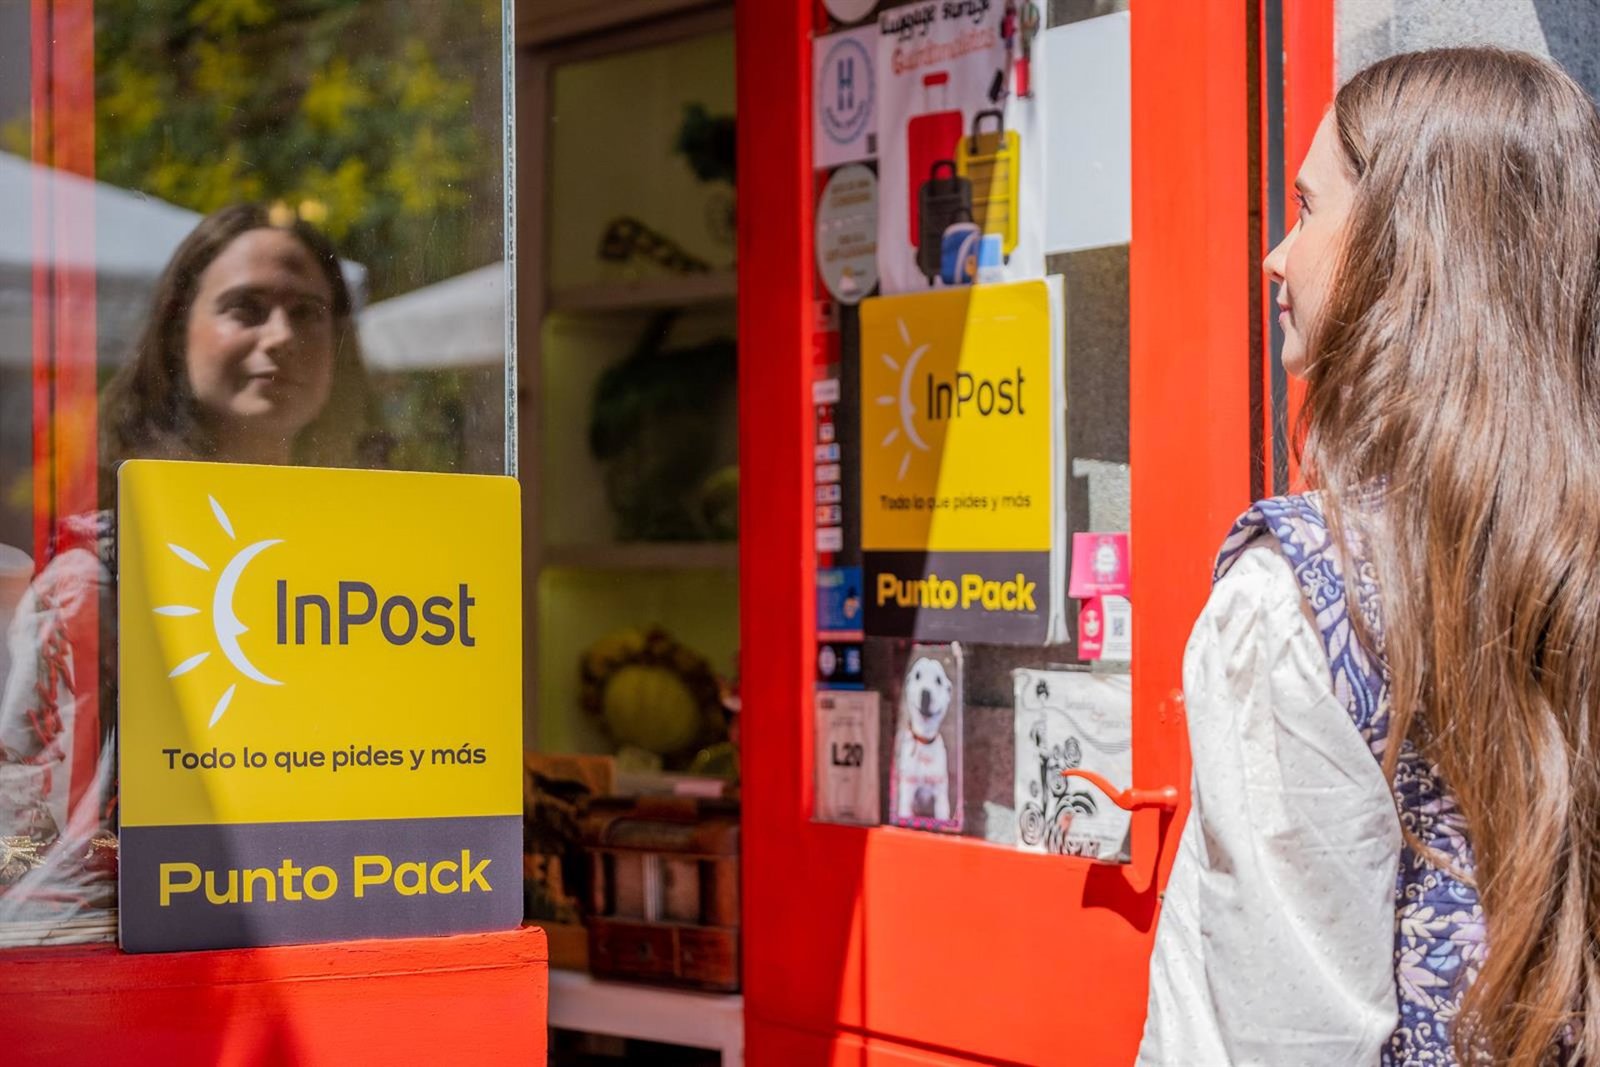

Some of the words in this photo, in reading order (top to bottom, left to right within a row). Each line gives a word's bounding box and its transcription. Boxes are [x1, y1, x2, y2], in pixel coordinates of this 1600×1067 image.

[927, 367, 1025, 421] InPost
[880, 494, 910, 510] Todo
[913, 493, 925, 510] lo
[926, 497, 949, 512] que
[953, 493, 988, 512] pides
[1001, 492, 1031, 508] más
[276, 579, 476, 648] InPost
[877, 573, 959, 610] Punto
[960, 572, 1037, 612] Pack
[162, 747, 236, 770] Todo
[243, 747, 267, 769] lo
[274, 751, 326, 773] que
[332, 744, 404, 772] pides
[409, 749, 425, 771] y
[431, 742, 487, 765] más
[159, 858, 339, 907] Punto
[353, 848, 493, 898] Pack
